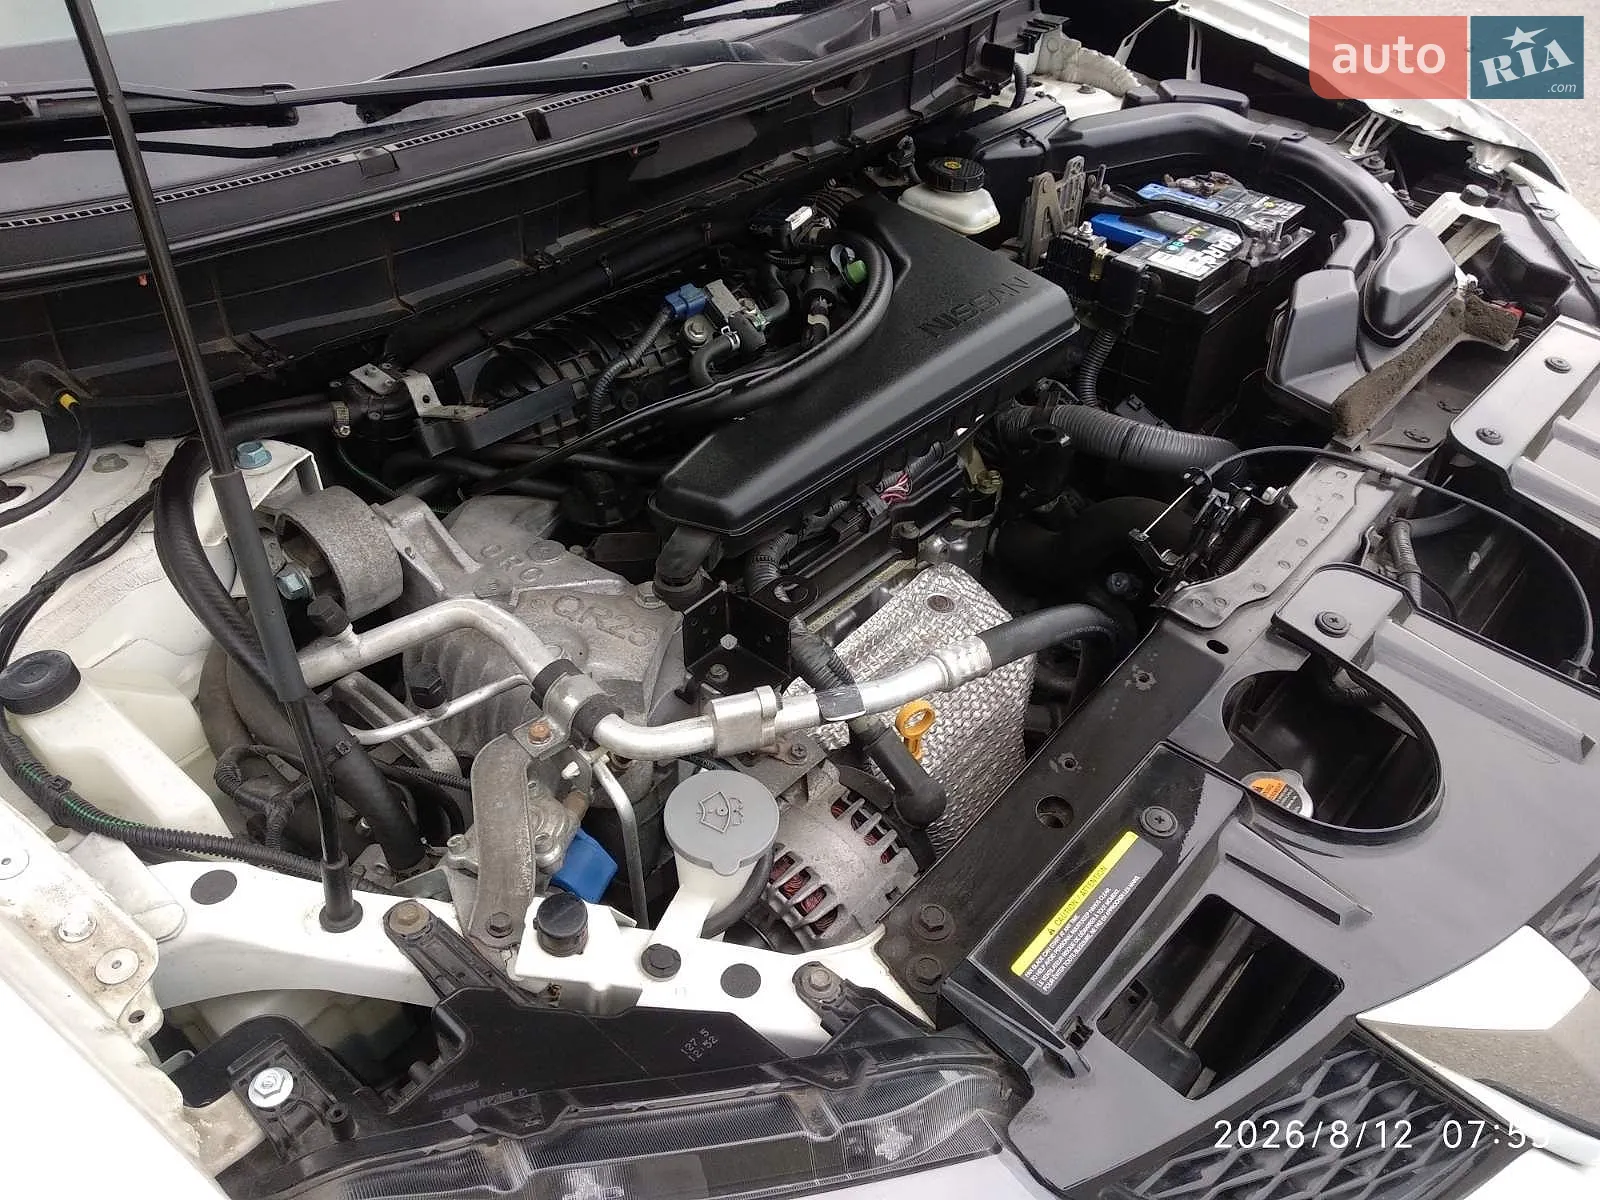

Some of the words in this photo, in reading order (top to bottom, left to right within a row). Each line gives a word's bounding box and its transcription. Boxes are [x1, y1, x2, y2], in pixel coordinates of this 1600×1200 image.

[918, 274, 1030, 338] NISSAN
[1054, 898, 1080, 926] CAUTION
[1080, 865, 1108, 897] ATTENTION
